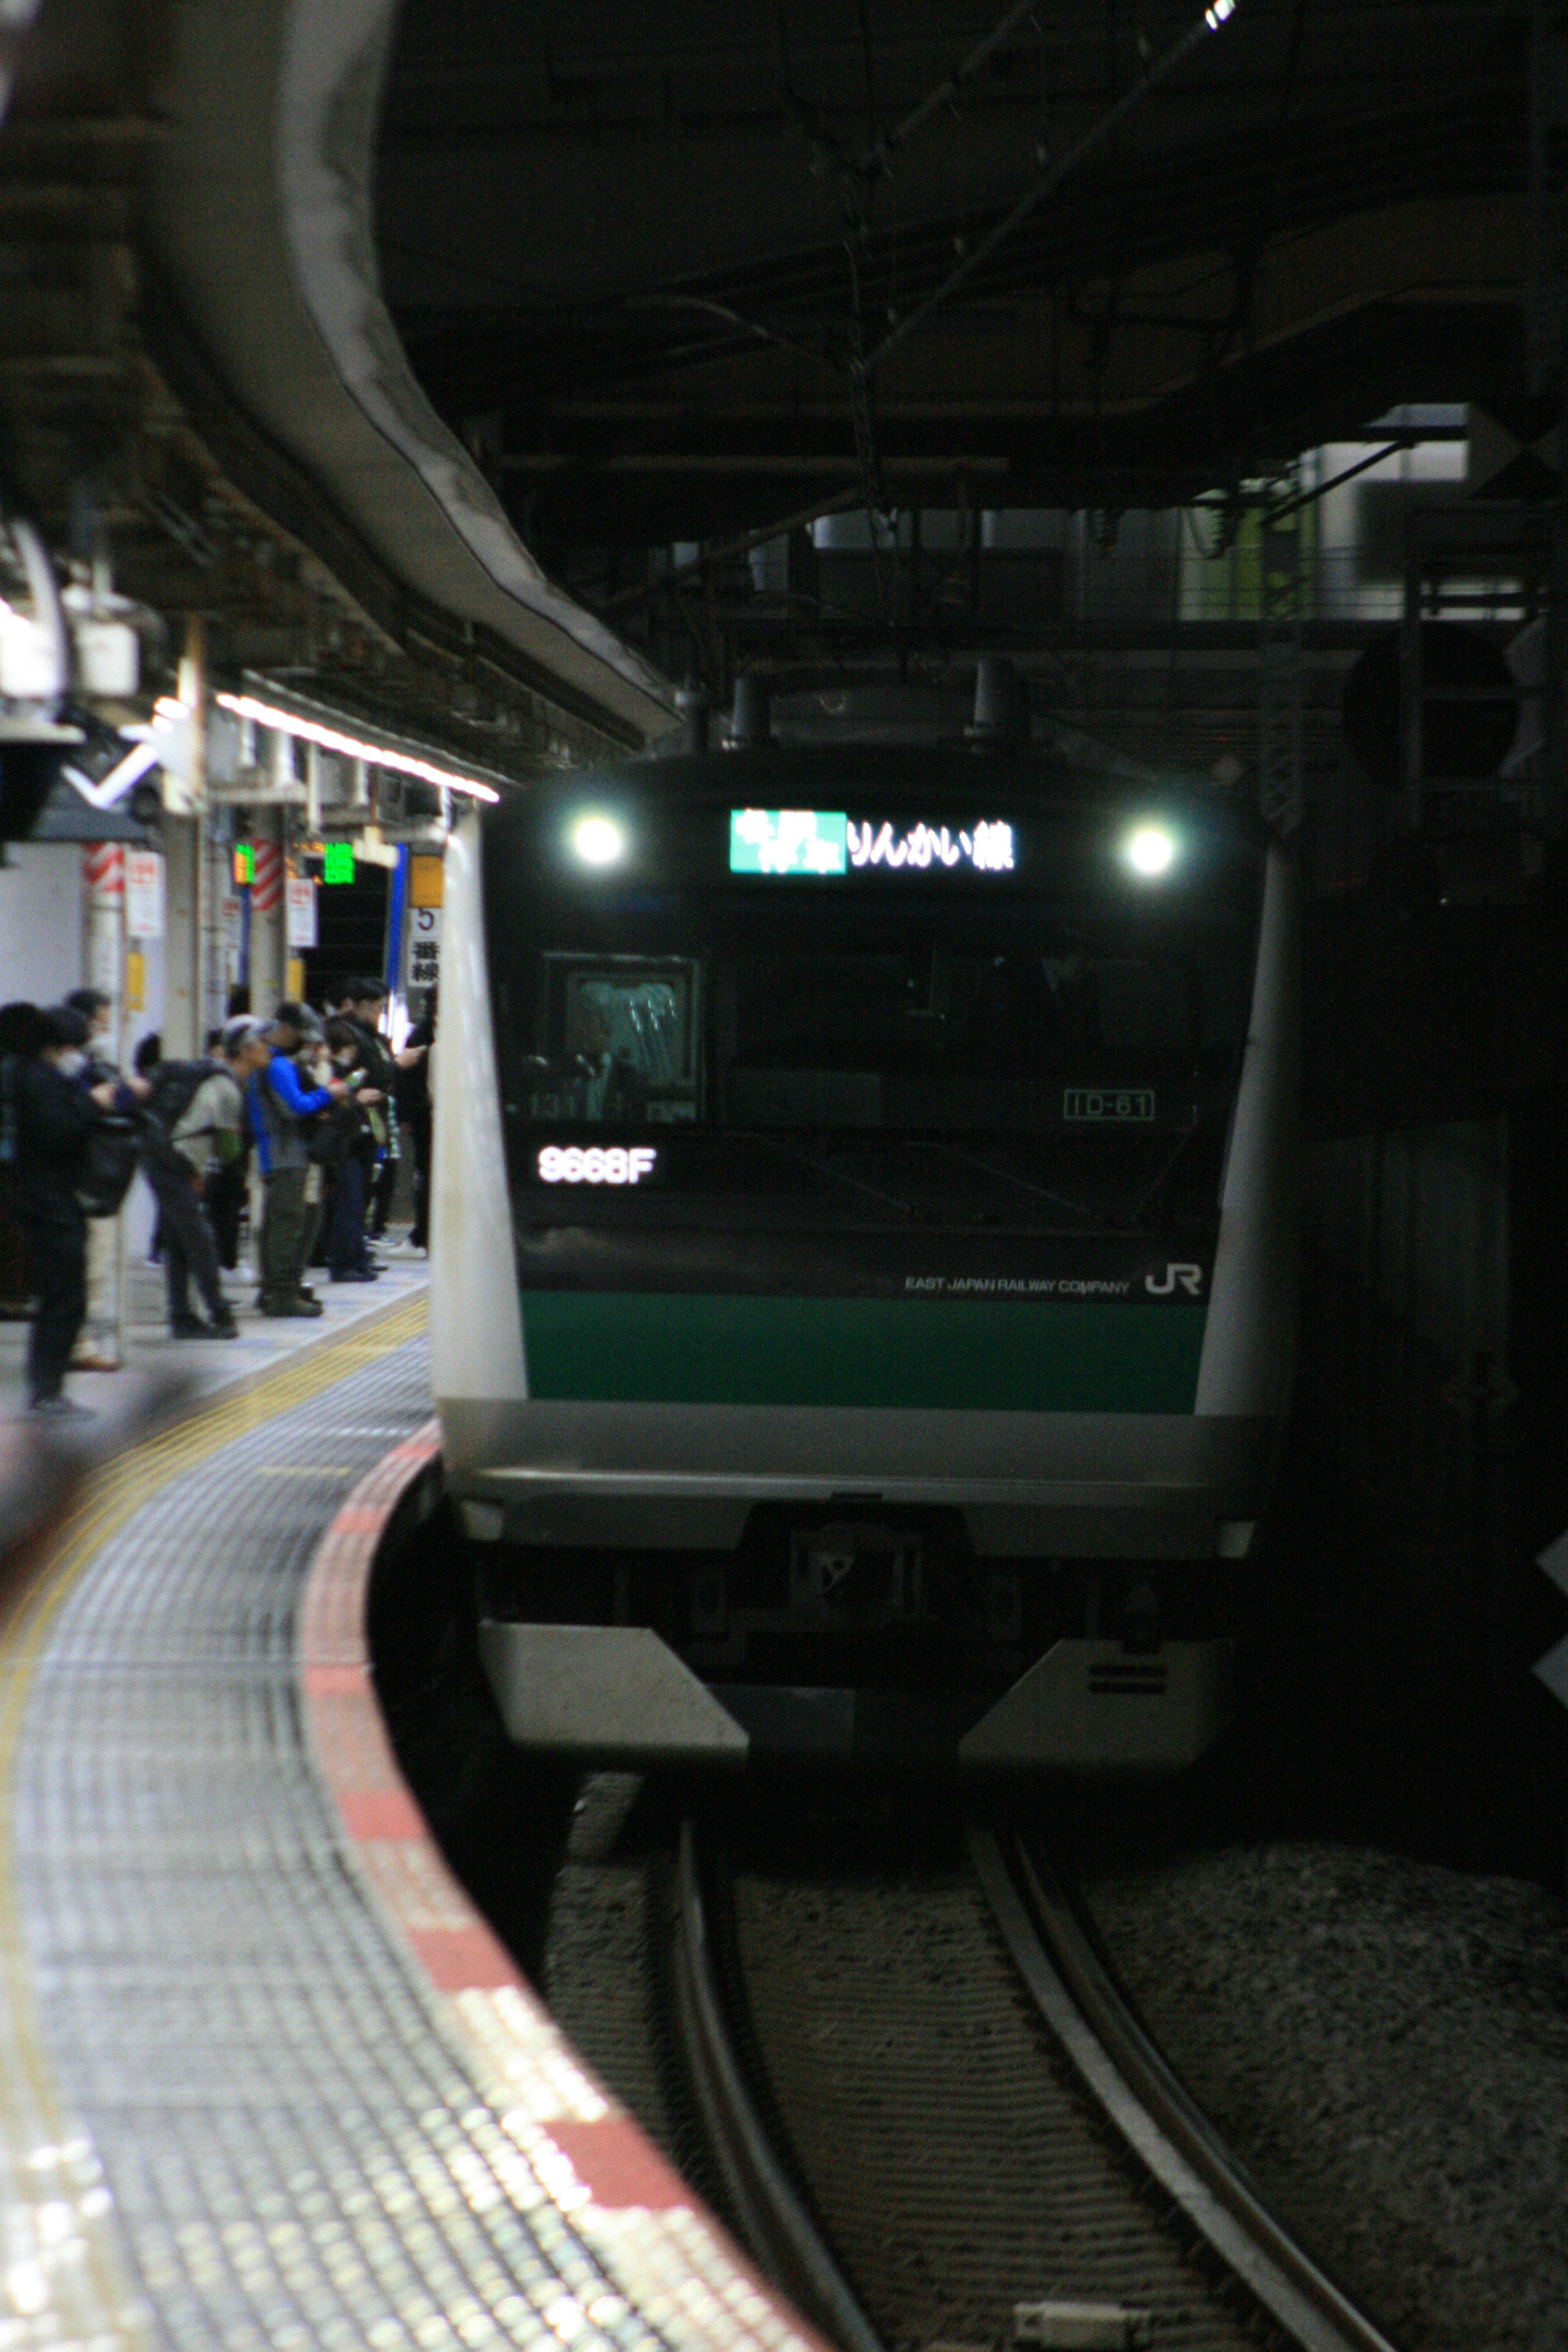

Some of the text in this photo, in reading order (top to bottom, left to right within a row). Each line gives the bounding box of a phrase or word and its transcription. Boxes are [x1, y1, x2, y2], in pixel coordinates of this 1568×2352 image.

[1074, 1094, 1146, 1116] ID-61
[906, 1277, 1130, 1295] EAST JAPAN RAILWAY COMPANY
[1145, 1263, 1203, 1295] JR
